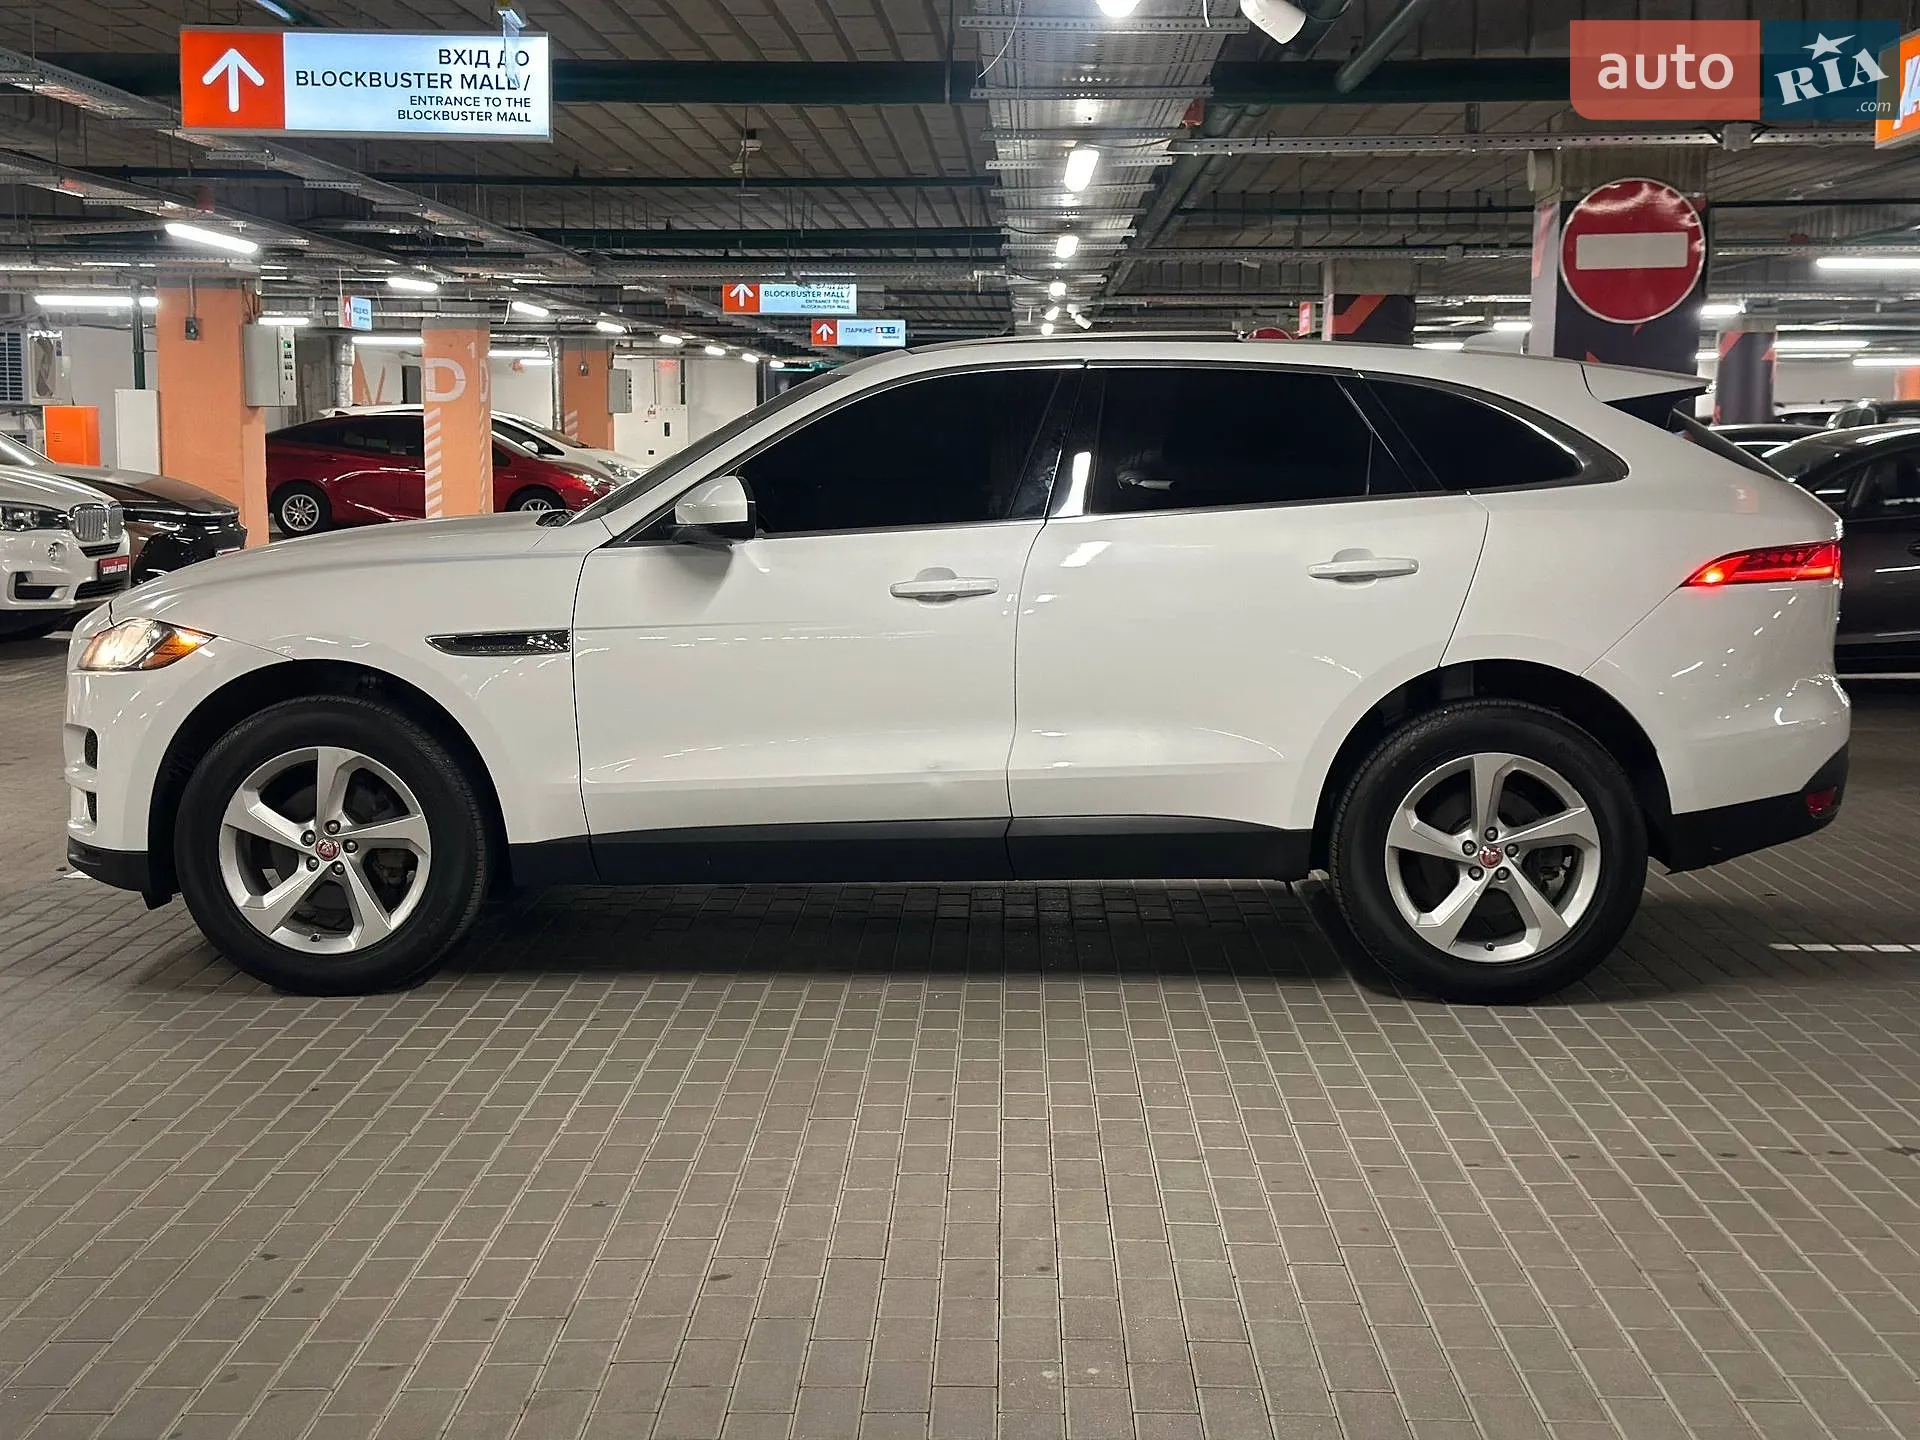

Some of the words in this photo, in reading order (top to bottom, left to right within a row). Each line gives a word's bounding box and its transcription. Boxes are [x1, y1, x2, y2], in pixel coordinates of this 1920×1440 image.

[439, 49, 490, 68] ВХІД
[295, 70, 452, 89] BLOCKBUSTER
[460, 73, 518, 90] MALL
[410, 95, 480, 107] ENTRANCE
[484, 96, 502, 107] TO
[507, 97, 531, 108] THE
[397, 110, 493, 122] BLOCKBUSTER
[497, 111, 531, 122] MALL
[764, 290, 821, 298] BLOCKBUSTER
